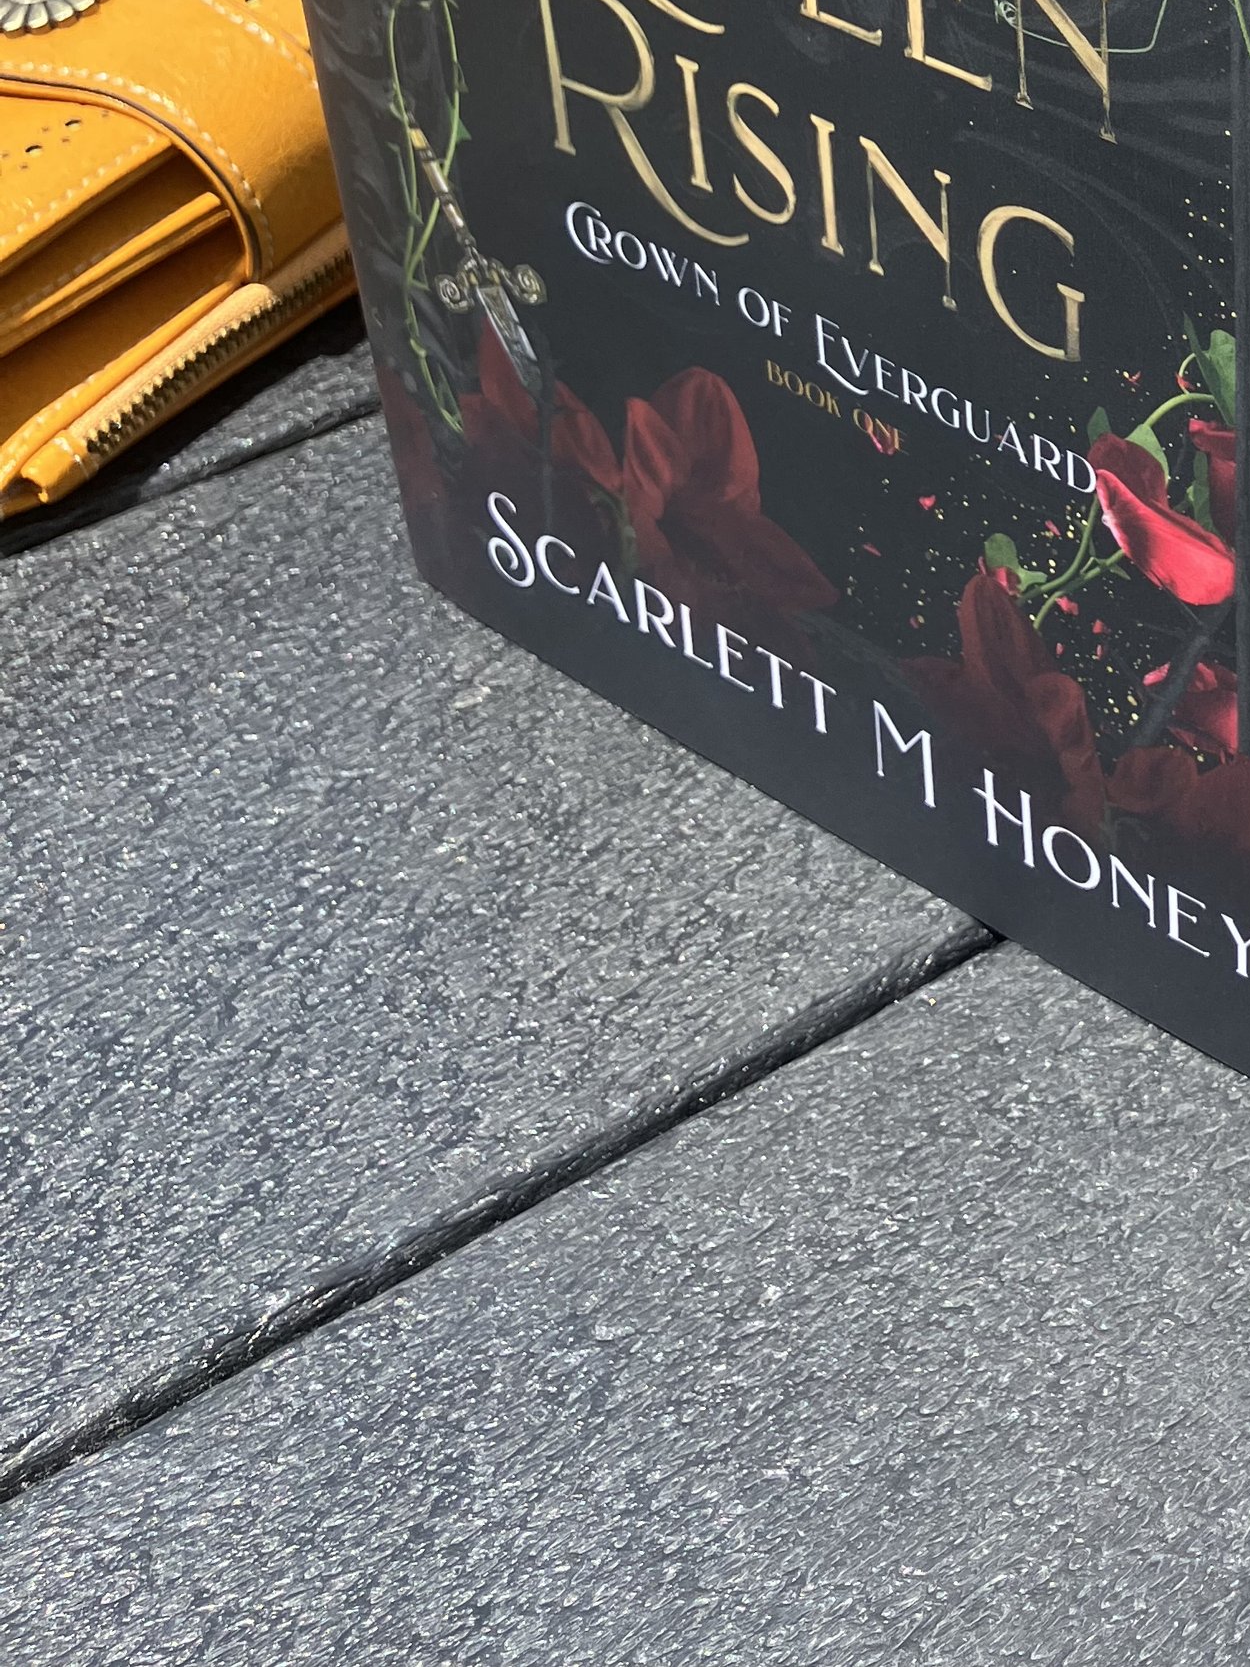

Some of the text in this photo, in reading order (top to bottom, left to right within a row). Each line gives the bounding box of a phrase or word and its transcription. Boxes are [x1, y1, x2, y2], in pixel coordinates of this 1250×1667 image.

[565, 200, 1096, 494] CROWN OF EVERGUARD
[766, 358, 909, 455] BOOK ONE
[486, 491, 837, 734] SCARLETT
[873, 700, 937, 808] M
